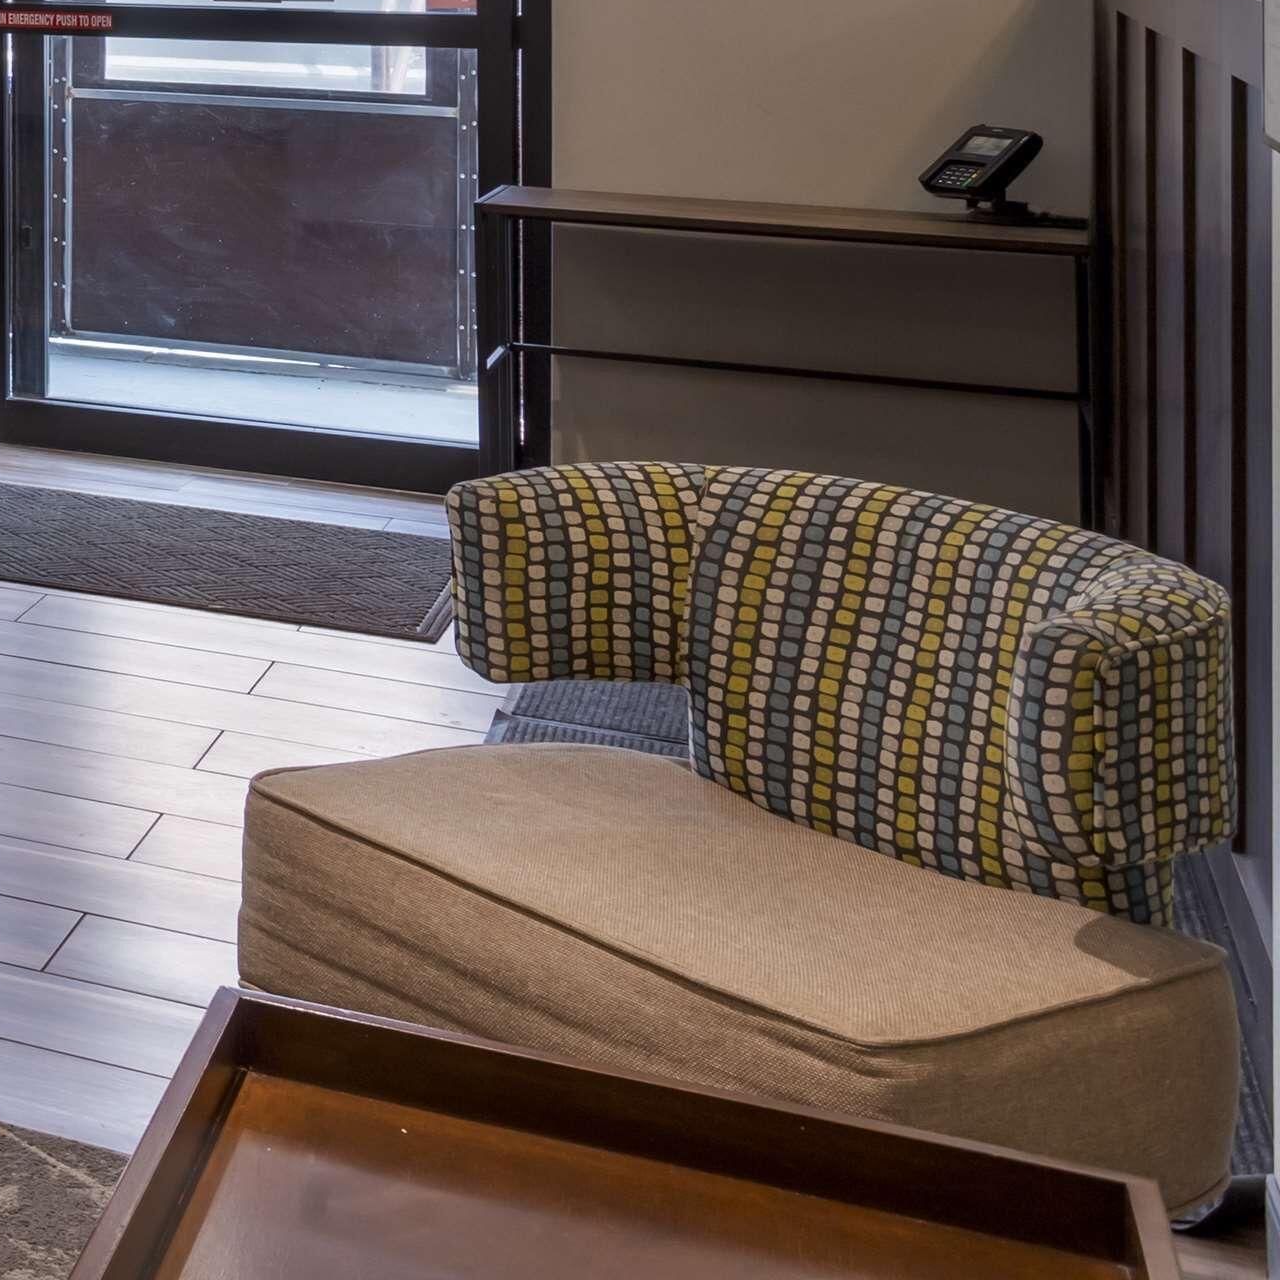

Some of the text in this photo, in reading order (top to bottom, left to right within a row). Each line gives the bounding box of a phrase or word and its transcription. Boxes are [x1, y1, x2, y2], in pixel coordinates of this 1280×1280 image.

[8, 12, 54, 25] EMERGENCY
[56, 14, 77, 26] PUSH
[79, 15, 89, 26] TO
[91, 15, 112, 27] OPEN
